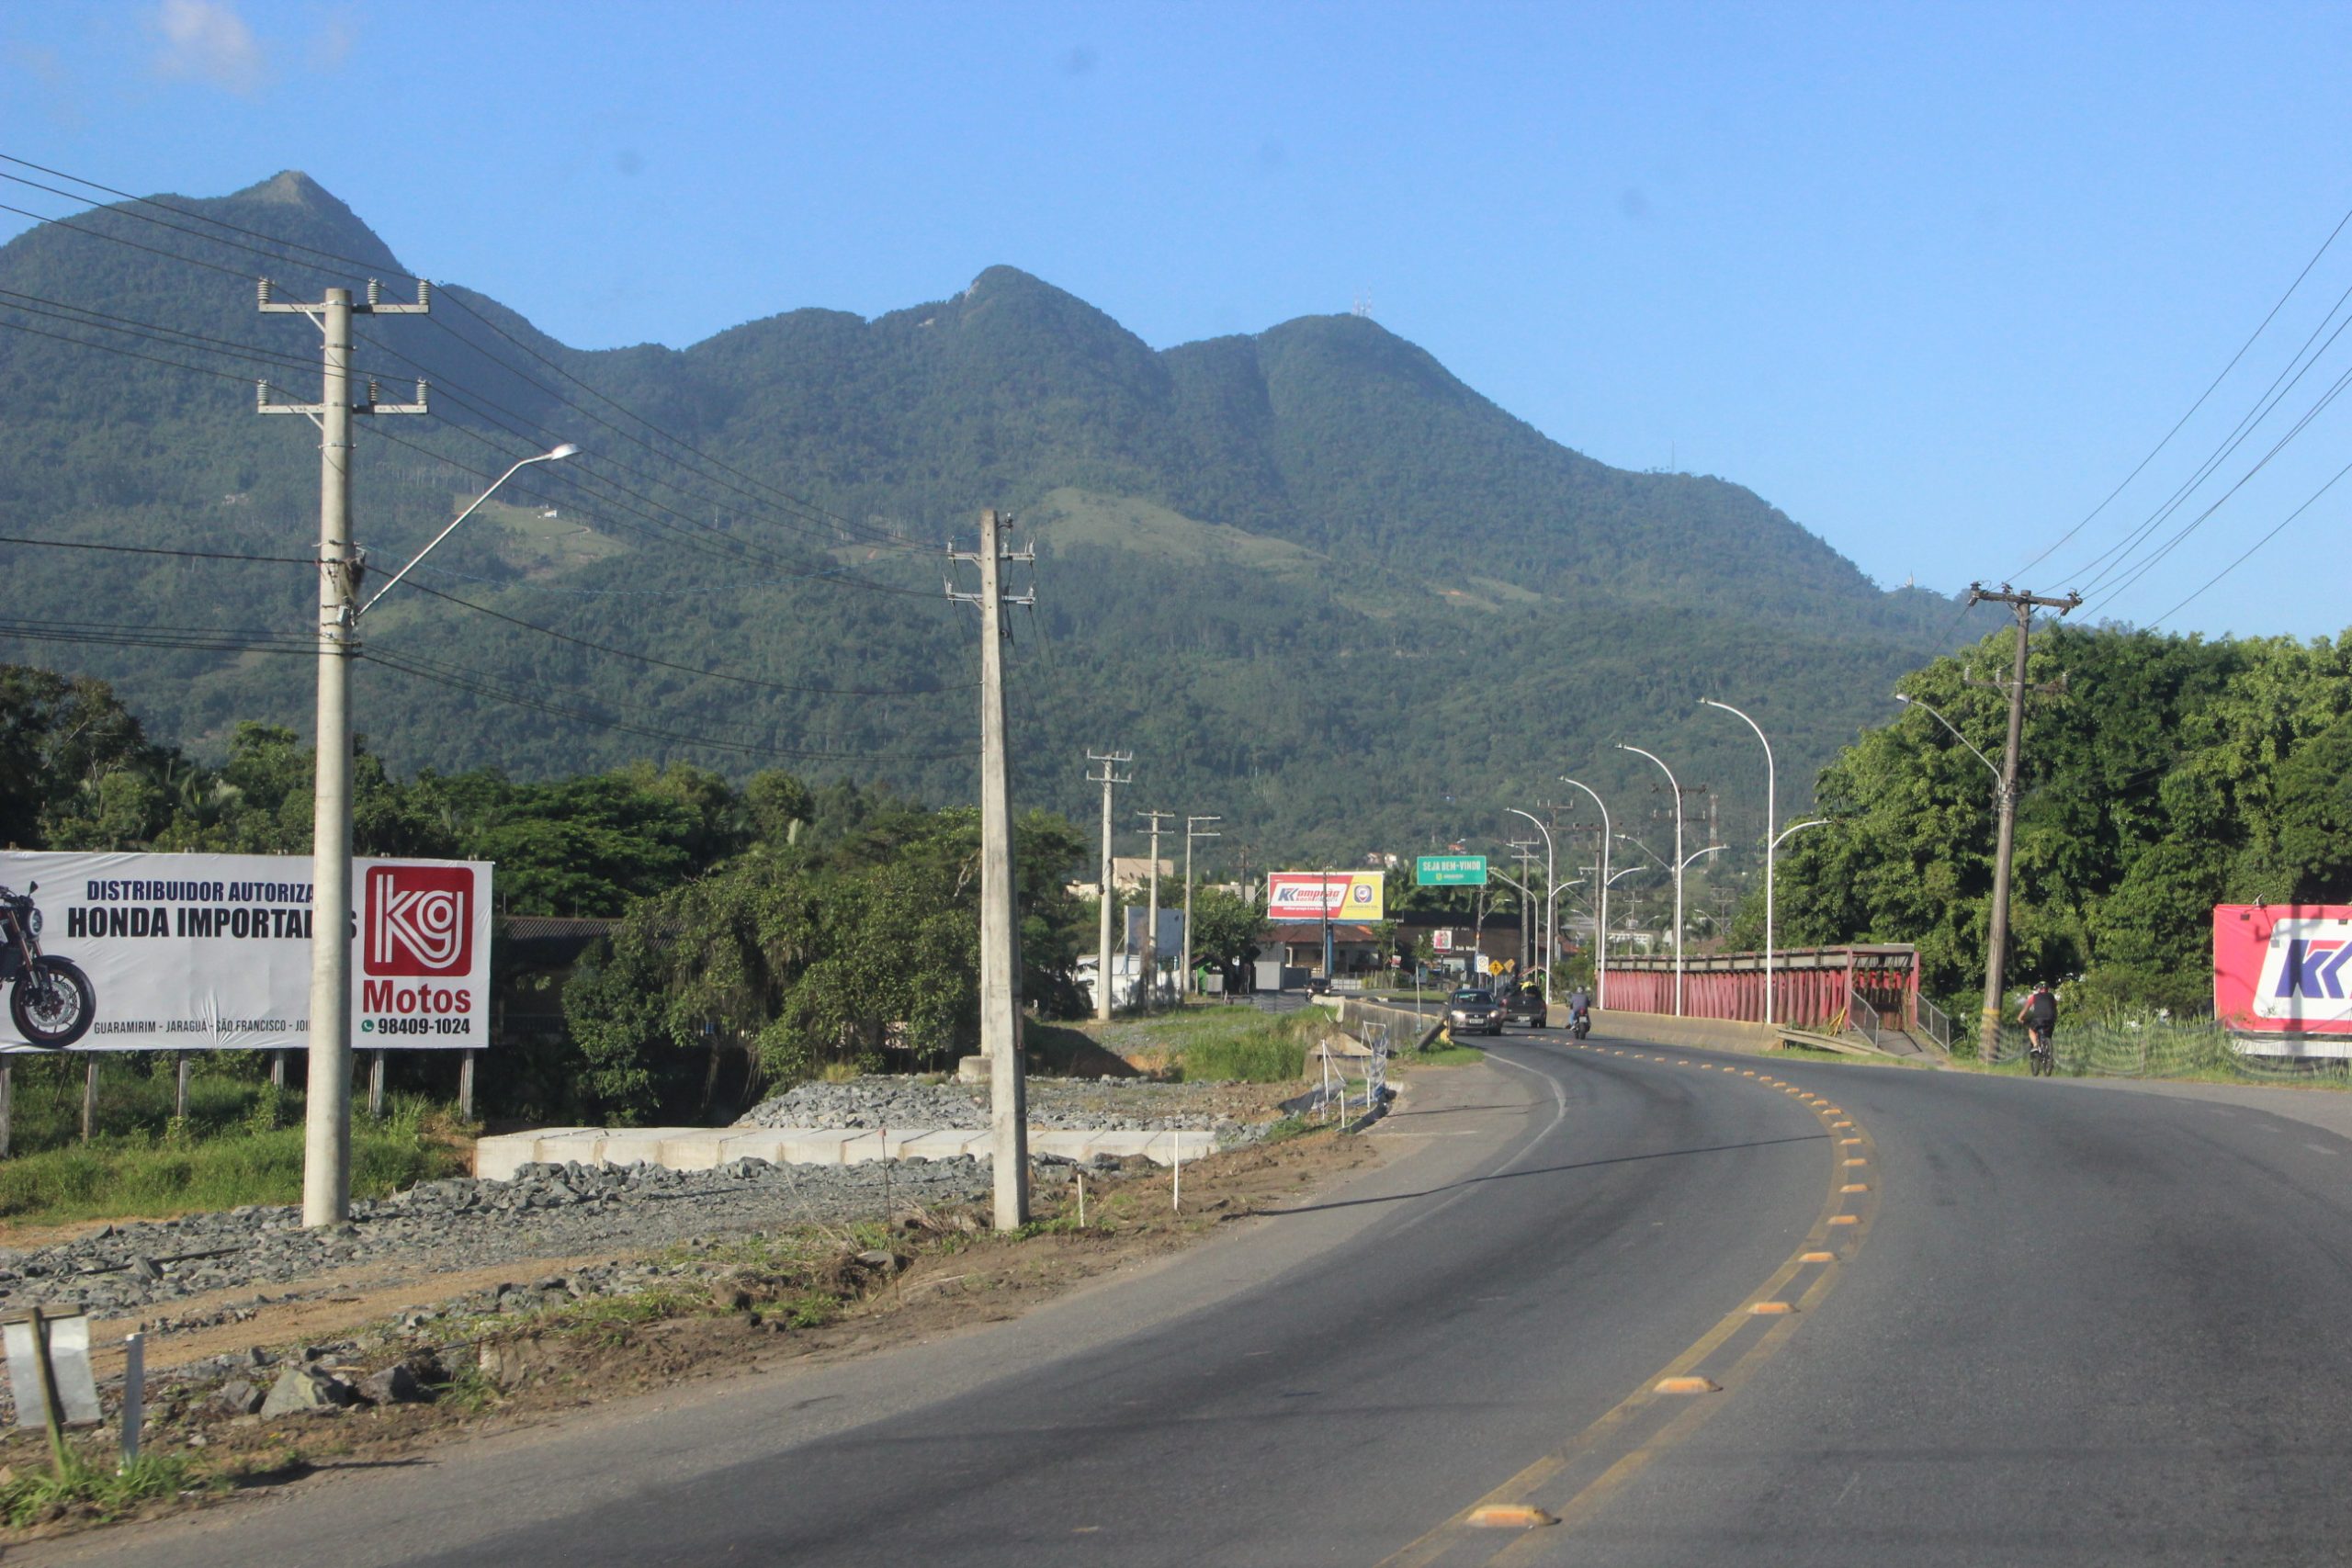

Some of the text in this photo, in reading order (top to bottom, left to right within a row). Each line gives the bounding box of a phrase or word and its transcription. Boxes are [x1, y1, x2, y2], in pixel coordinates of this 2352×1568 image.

[1423, 861, 1440, 871] SEJA
[87, 880, 313, 903] DISTRIBUIDOR AUTORIZA
[68, 907, 356, 939] HONDA IMPORTA
[362, 979, 471, 1014] Motos
[95, 1021, 156, 1034] GUARAMIRIM
[165, 1018, 208, 1032] JARAGUÁ
[216, 1018, 233, 1032] SÃO
[236, 1019, 287, 1032] FRANCISCO
[295, 1019, 311, 1032] JOI
[378, 1018, 470, 1034] 98409-1024
